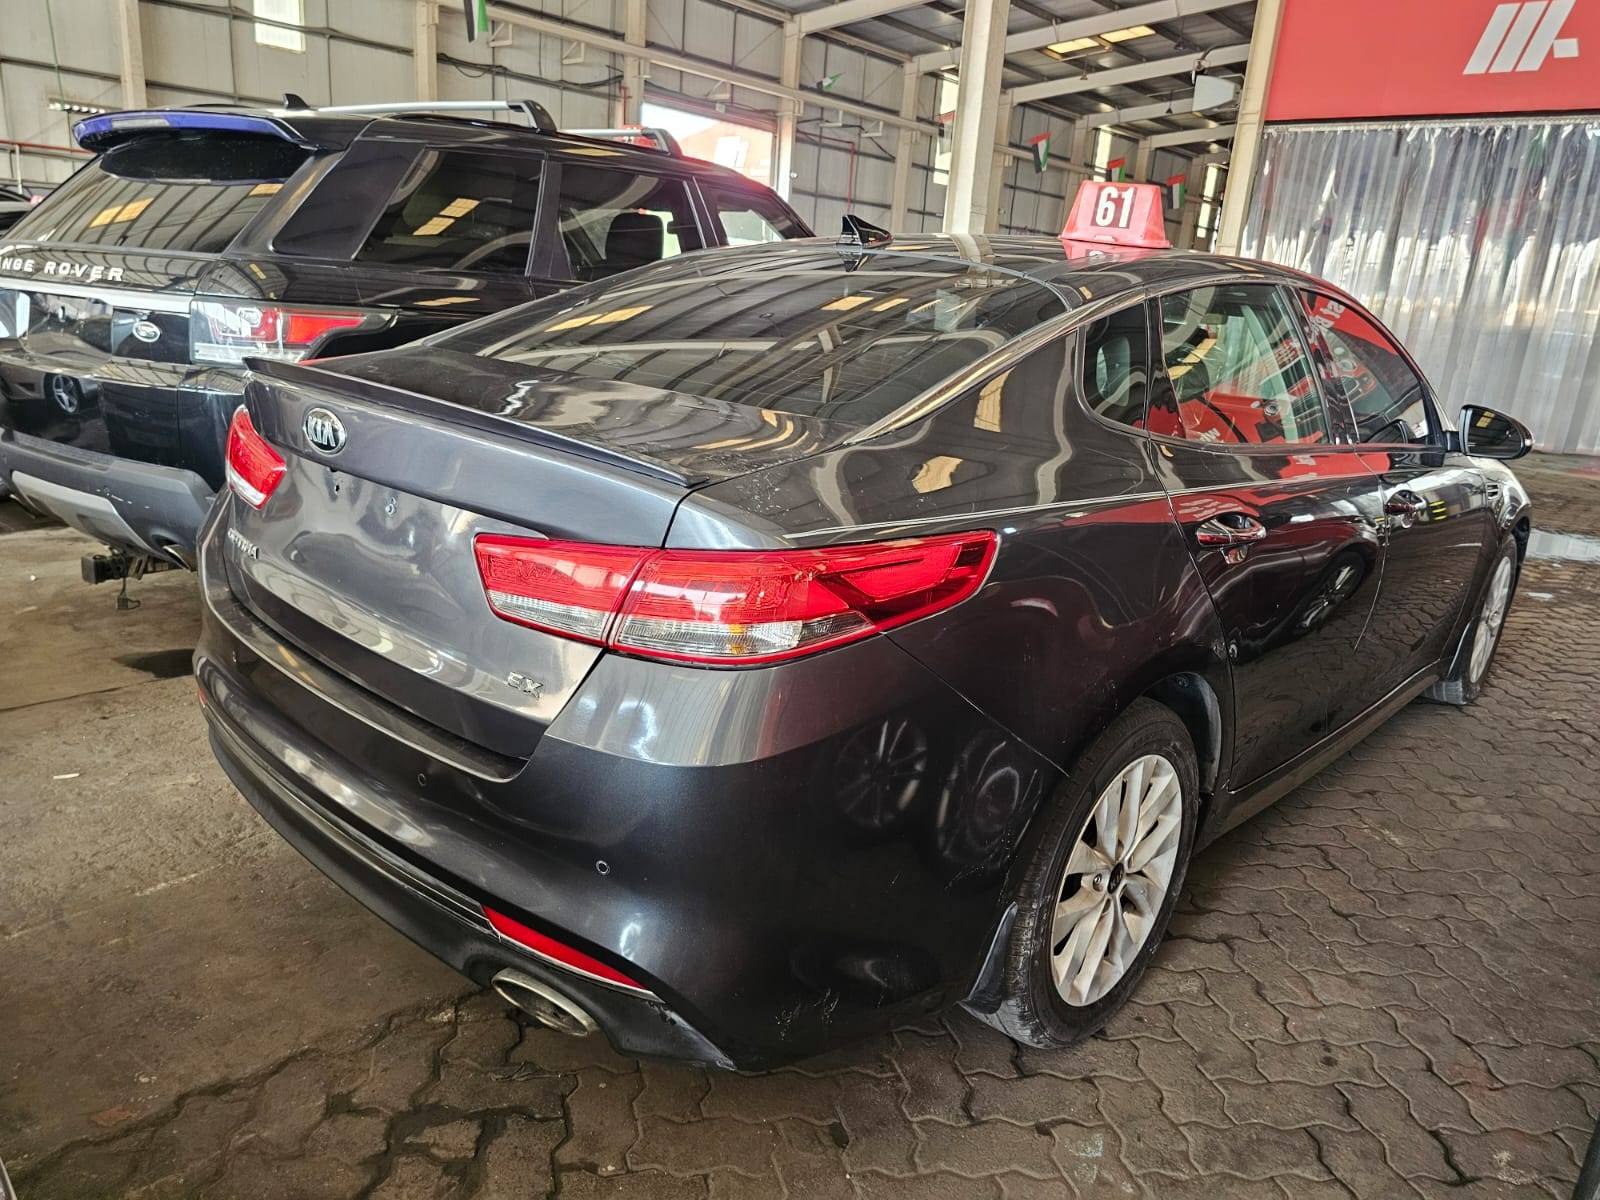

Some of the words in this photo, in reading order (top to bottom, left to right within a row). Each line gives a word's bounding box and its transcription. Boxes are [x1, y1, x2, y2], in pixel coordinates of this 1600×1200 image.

[1095, 186, 1135, 228] 61
[0, 257, 35, 273] NGE
[44, 261, 124, 282] ROVER
[307, 415, 336, 447] KIA
[507, 671, 543, 698] EX
